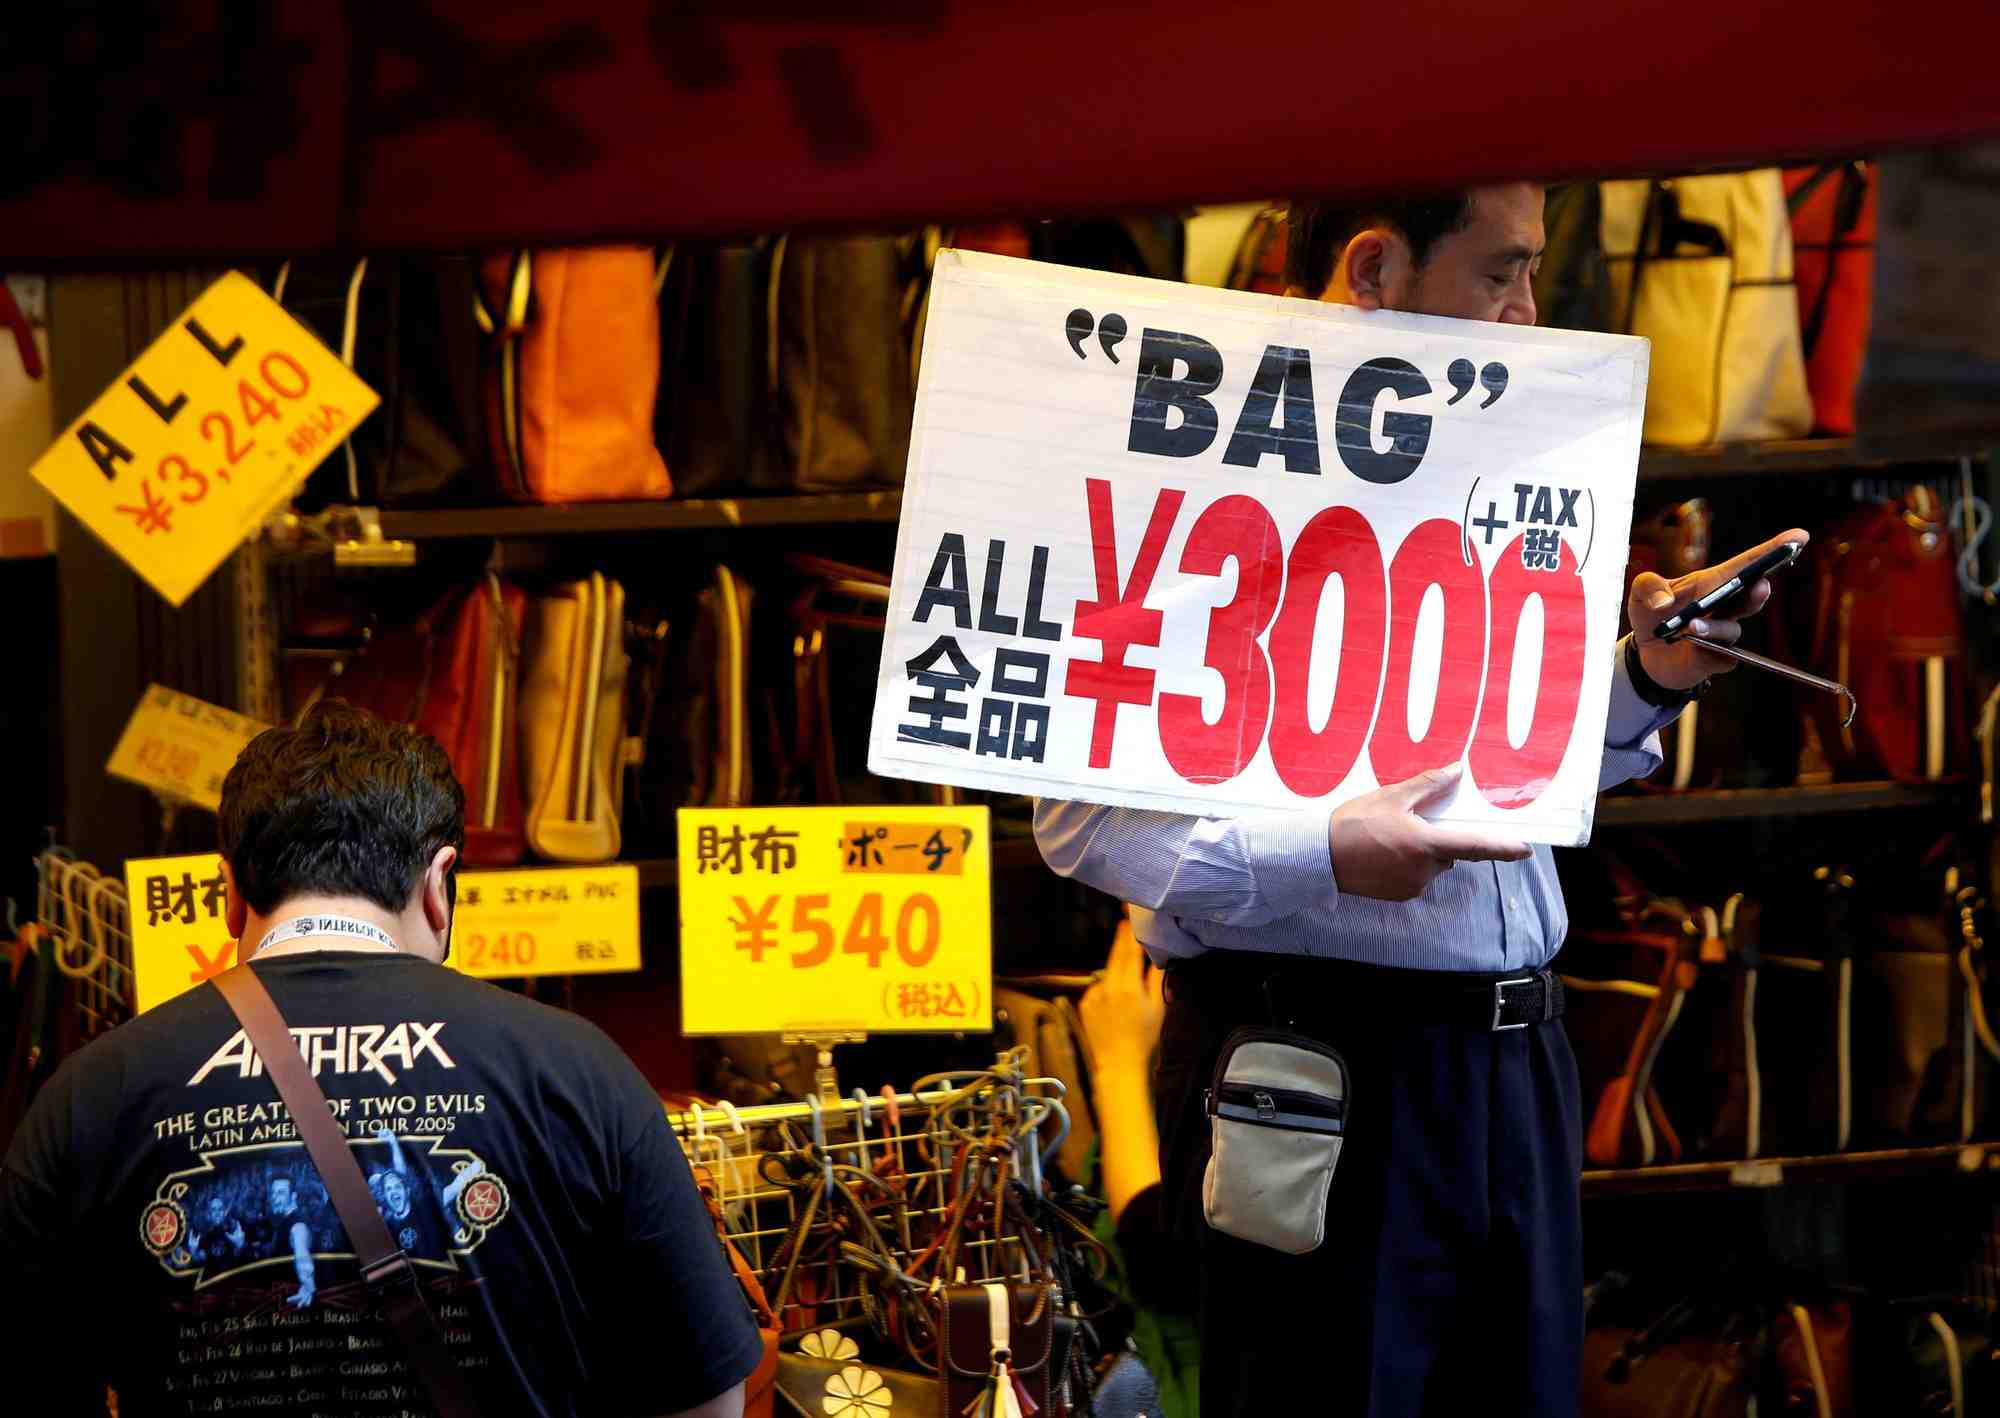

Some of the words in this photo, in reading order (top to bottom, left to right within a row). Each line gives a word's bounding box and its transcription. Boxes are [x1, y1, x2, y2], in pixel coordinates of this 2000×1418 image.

[116, 351, 311, 536] ¥3,240
[1514, 483, 1581, 528] TAX
[912, 533, 1062, 642] ALL
[1064, 477, 1585, 810] ¥3000
[898, 634, 1050, 764] 全品
[698, 825, 799, 875] 財布
[728, 892, 941, 969] ¥540
[882, 982, 981, 1018] (税込)
[185, 1022, 456, 1087] ATHRAX
[154, 1112, 197, 1140] THE
[204, 1102, 291, 1127] GREAT
[360, 1095, 416, 1116] TWO
[426, 1094, 486, 1113] EVILS
[190, 1128, 244, 1150] LATIN
[357, 1117, 409, 1135] TOUR
[415, 1116, 456, 1132] 2005
